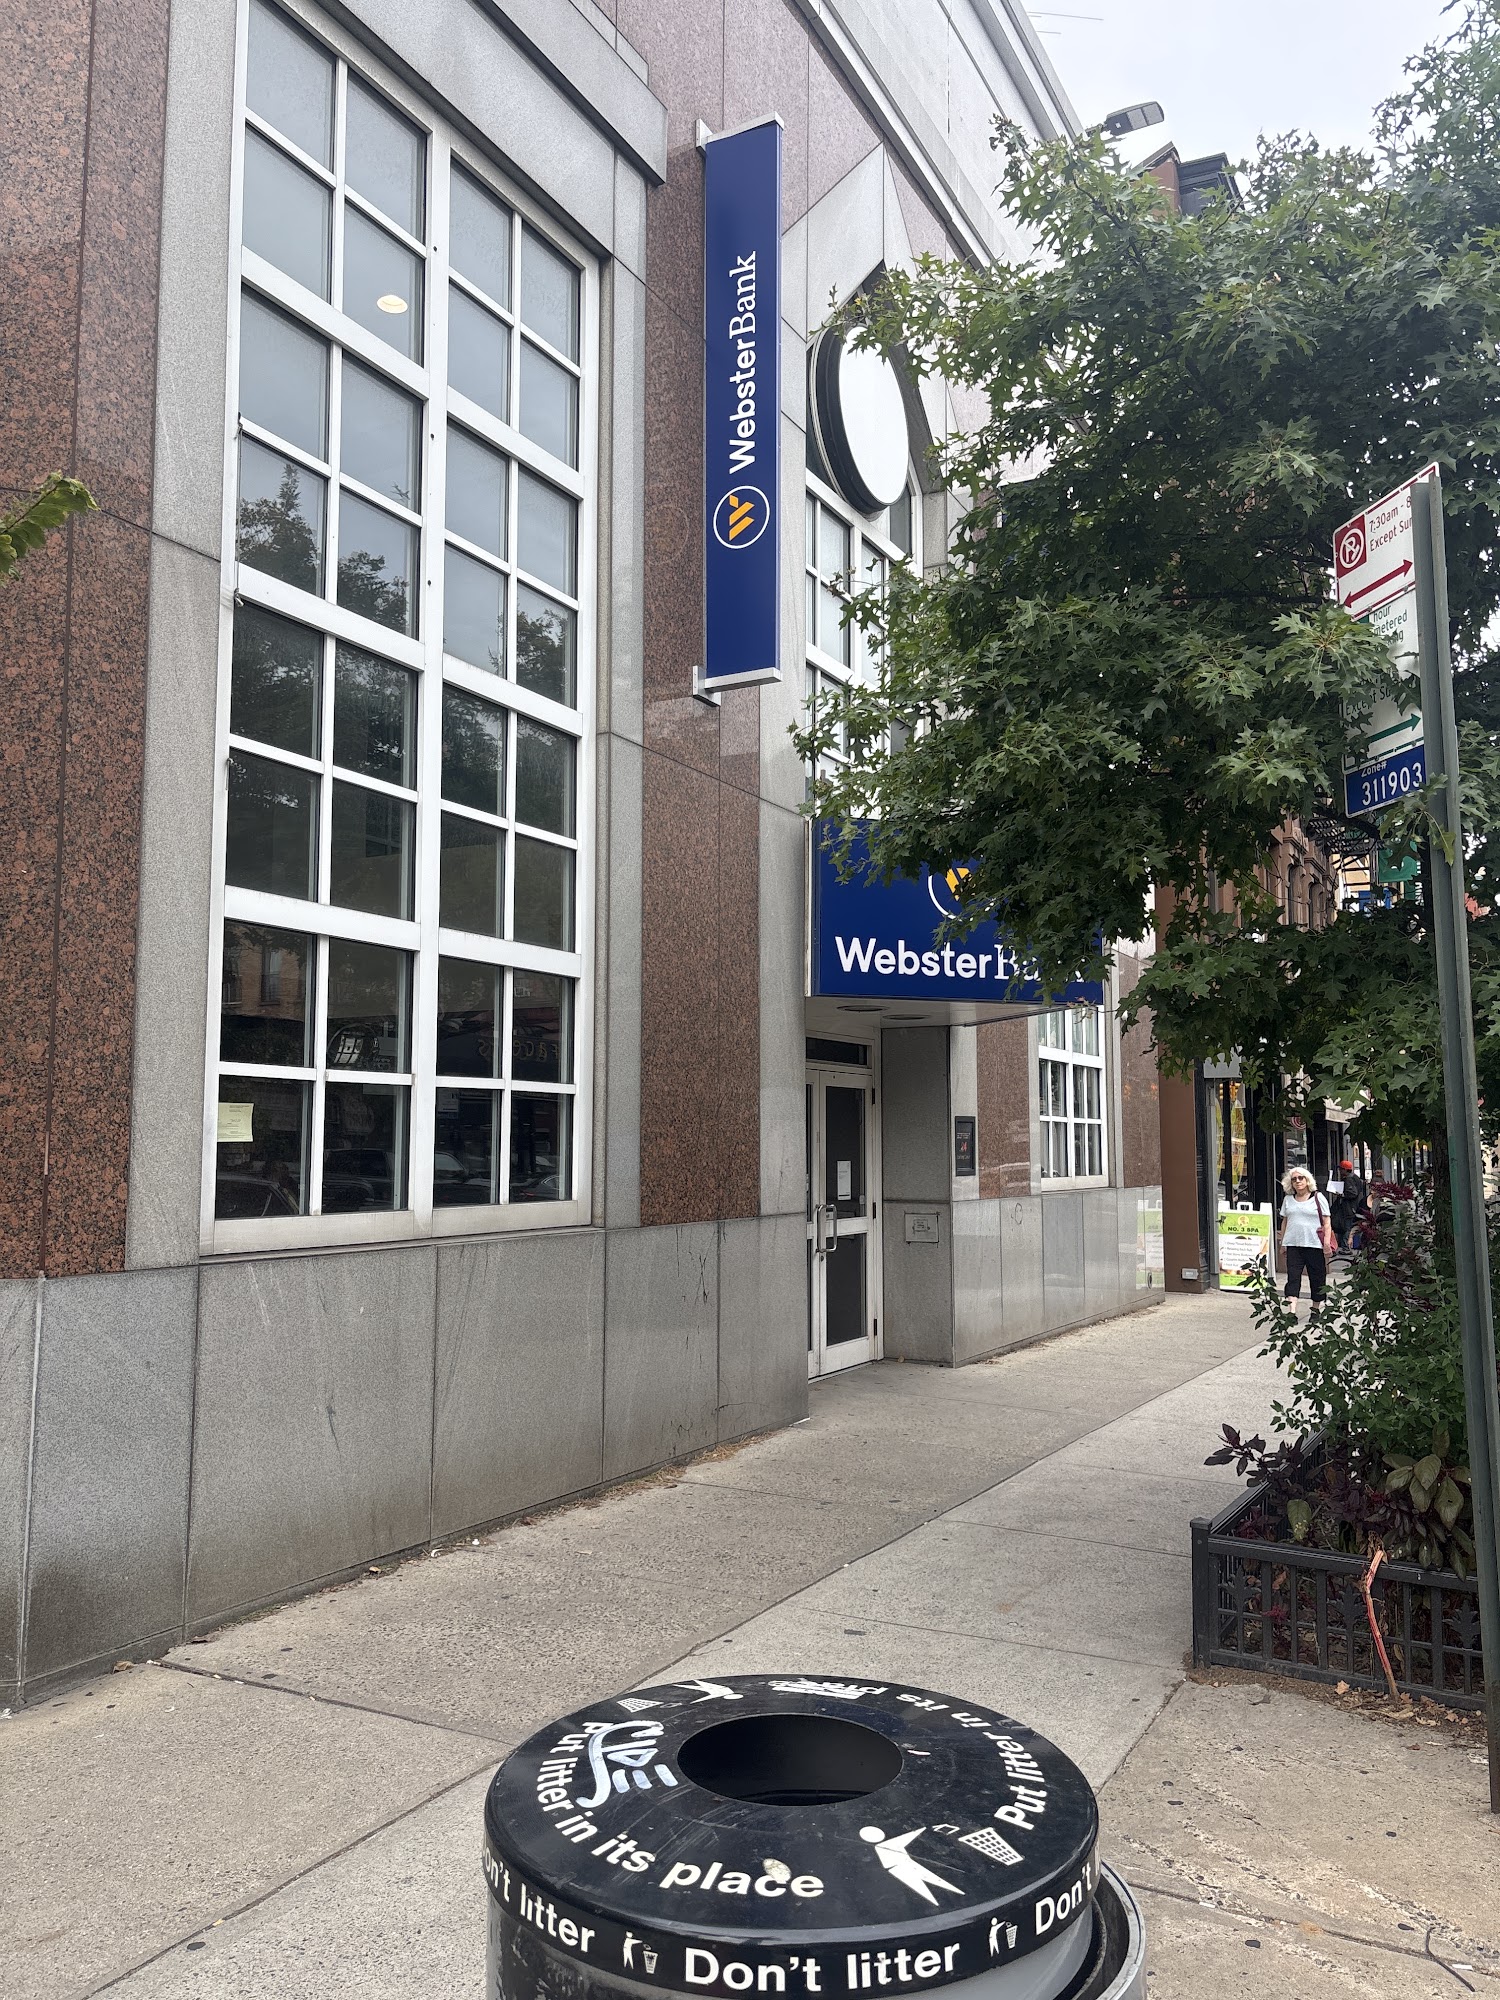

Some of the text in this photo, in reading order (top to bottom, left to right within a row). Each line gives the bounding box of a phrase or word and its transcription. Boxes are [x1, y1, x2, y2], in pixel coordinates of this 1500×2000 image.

[728, 250, 757, 474] WebsterBank
[1369, 507, 1399, 533] 7:30am
[1370, 525, 1397, 552] Except
[1373, 605, 1391, 622] hour
[1361, 761, 1387, 778] Zone#
[1362, 762, 1423, 806] 311903
[896, 1693, 949, 1711] its
[951, 1712, 992, 1728] in
[982, 1731, 1045, 1782] litter
[537, 1757, 578, 1811] litter
[555, 1811, 598, 1843] in
[994, 1785, 1048, 1830] Put
[591, 1833, 656, 1872] its
[482, 1846, 596, 1952] on't litter
[659, 1861, 824, 1898] place
[1035, 1861, 1092, 1935] Don't
[685, 1942, 960, 1992] Don't litter
